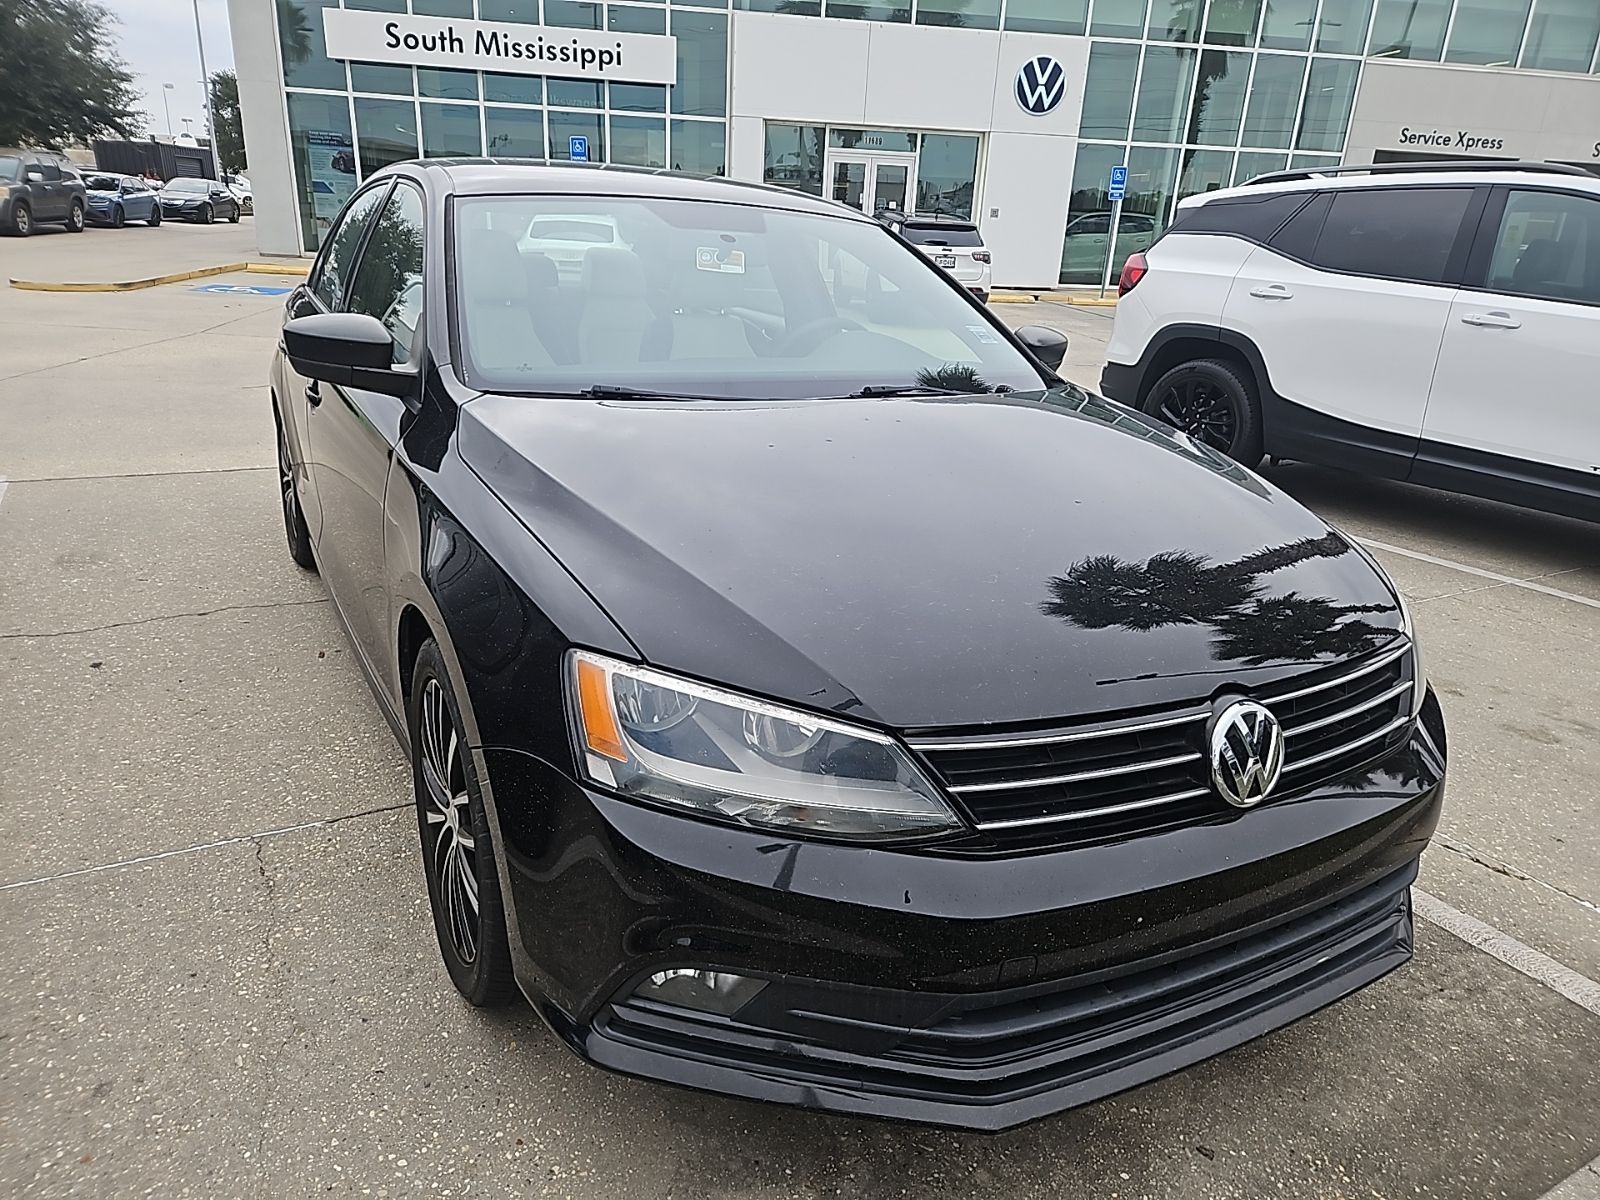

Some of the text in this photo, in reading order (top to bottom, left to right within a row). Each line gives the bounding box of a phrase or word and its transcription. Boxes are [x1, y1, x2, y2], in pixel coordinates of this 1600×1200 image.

[385, 22, 621, 71] South Mississippi
[1018, 56, 1066, 112] VW
[1399, 127, 1503, 151] Service Xpress
